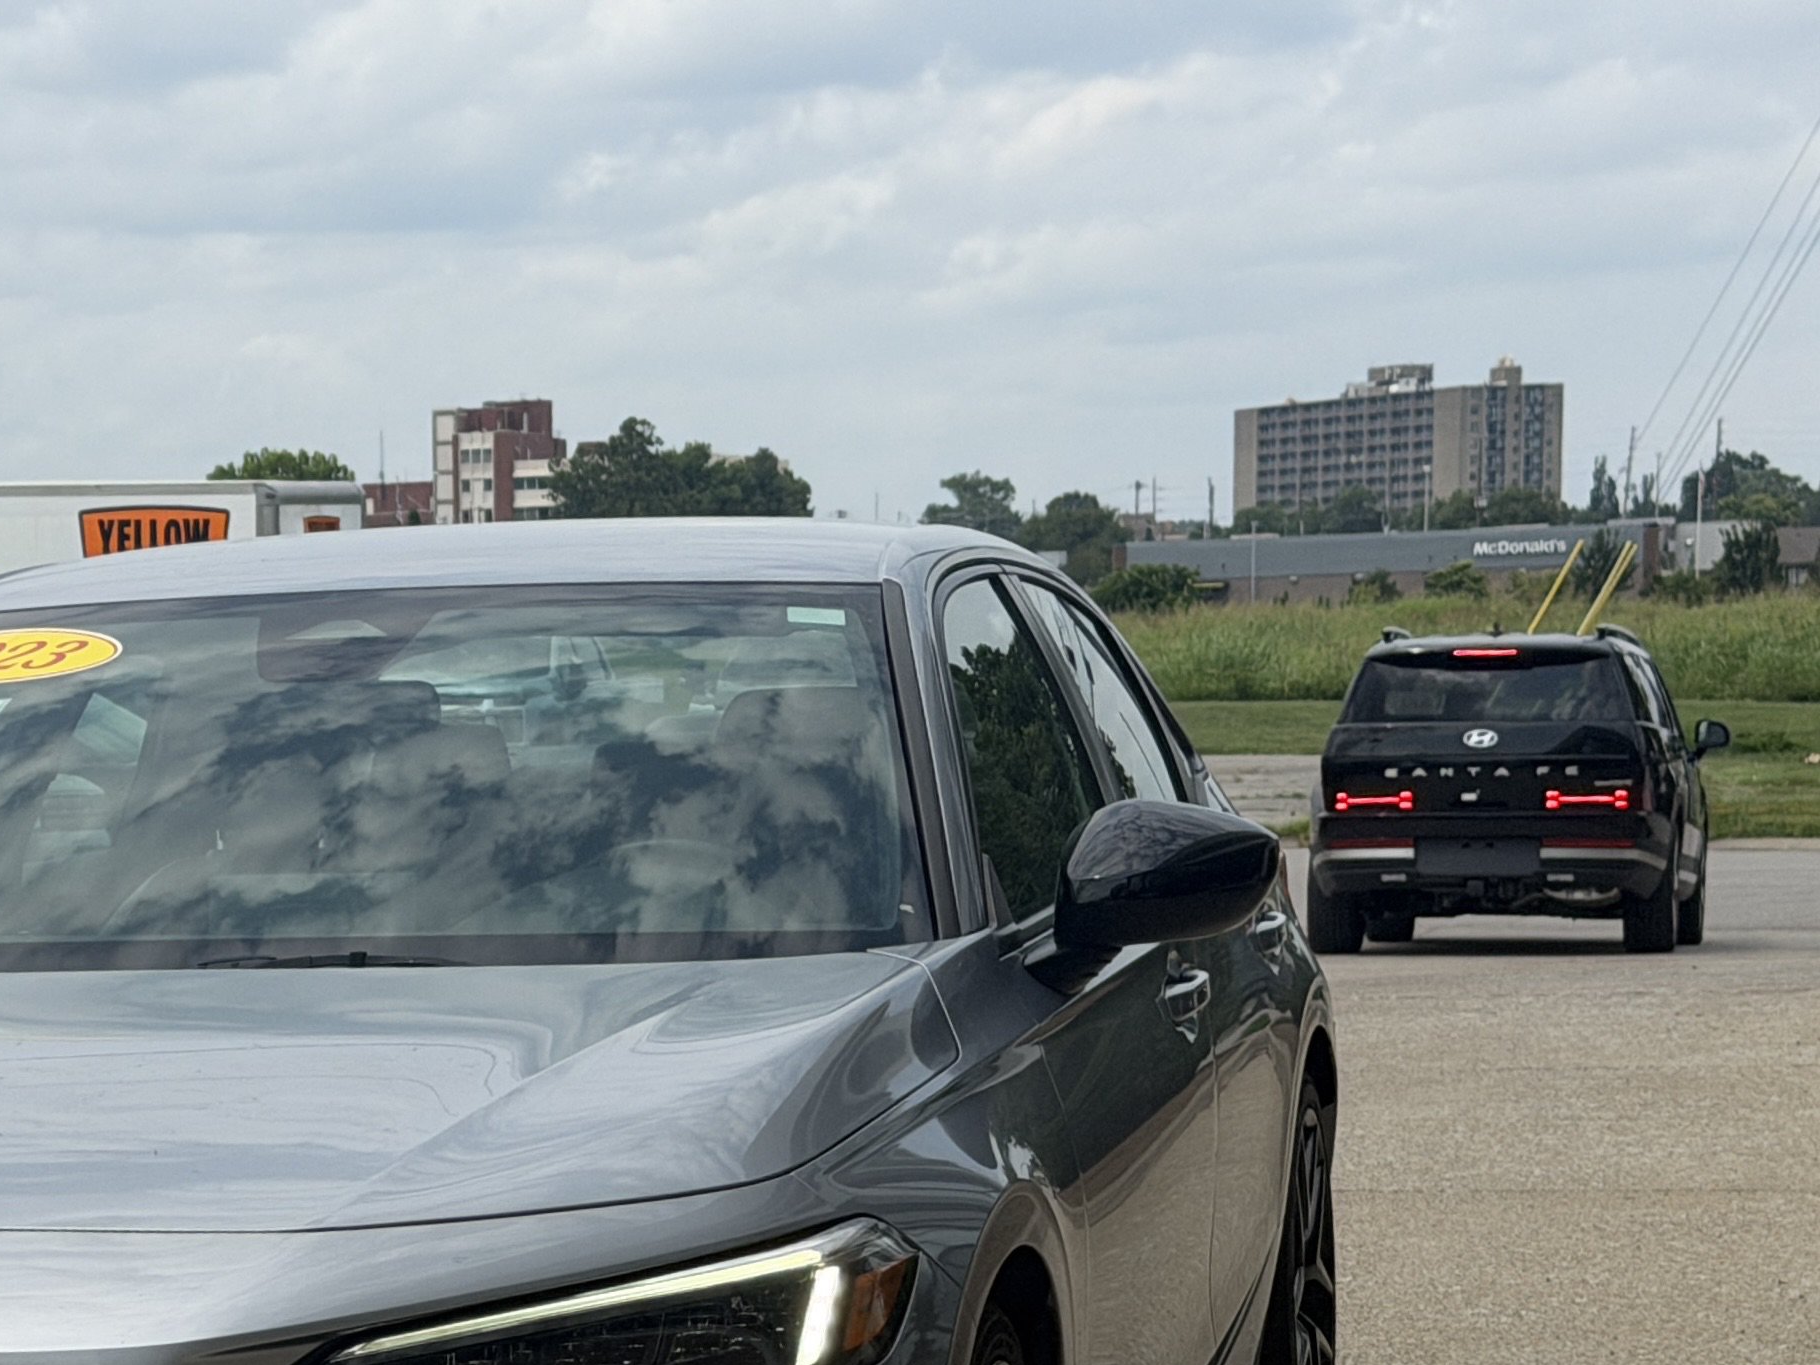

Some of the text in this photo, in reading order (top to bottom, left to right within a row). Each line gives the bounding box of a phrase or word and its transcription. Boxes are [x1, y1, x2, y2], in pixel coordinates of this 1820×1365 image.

[97, 518, 211, 555] YELLOW
[1473, 539, 1567, 557] McDonald's
[1384, 765, 1580, 779] SANTA FE
